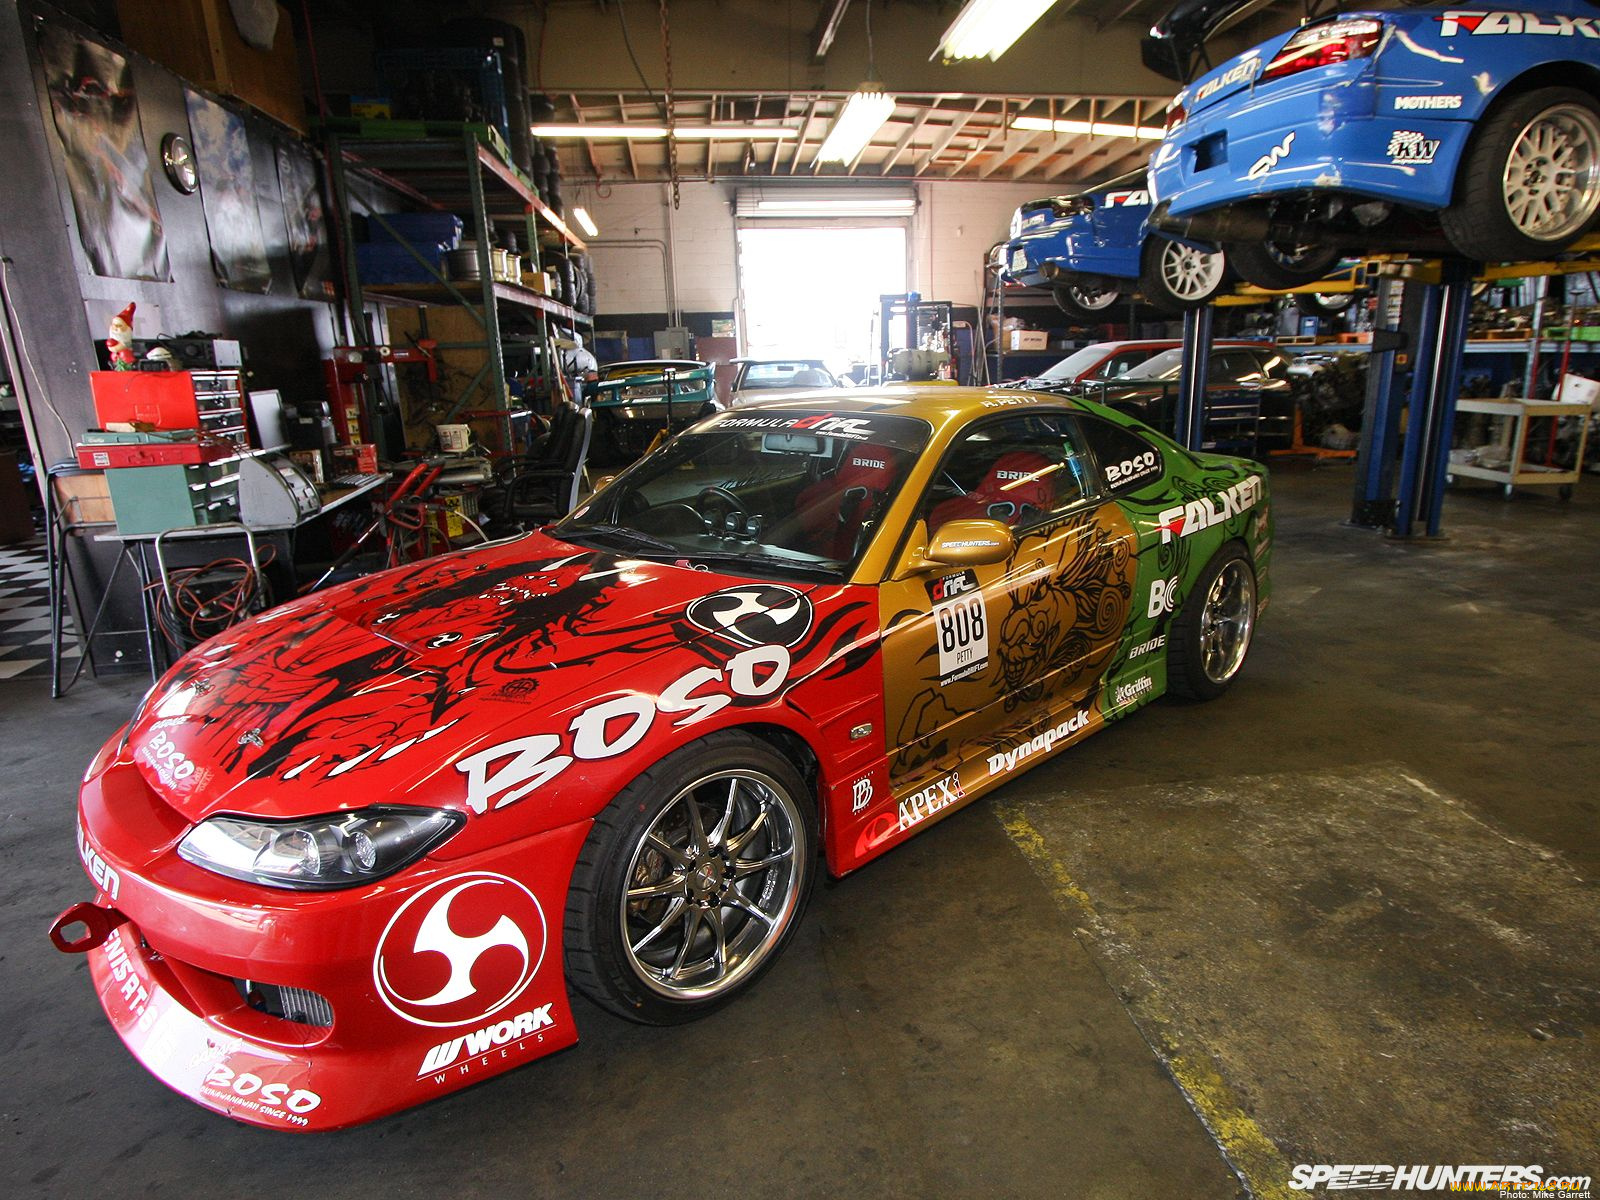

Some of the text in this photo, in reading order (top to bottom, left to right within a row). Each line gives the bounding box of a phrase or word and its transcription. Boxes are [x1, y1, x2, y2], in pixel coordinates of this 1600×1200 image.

[1439, 11, 1600, 38] FALK
[1394, 95, 1462, 110] MOTHERS
[1397, 139, 1441, 159] KW
[713, 418, 799, 429] FORMULA
[852, 457, 886, 470] BRIDE
[1104, 451, 1155, 482] BOSO
[1155, 474, 1262, 545] FALKEN
[942, 570, 966, 581] FORMULA
[938, 597, 985, 654] 808
[956, 646, 974, 665] PETTY
[1129, 633, 1167, 660] BRIDE
[1124, 676, 1153, 697] Griffin
[455, 645, 791, 816] BOSO
[986, 709, 1090, 776] Dynapack
[149, 731, 195, 779] BOSO
[466, 1002, 554, 1057] WORK
[434, 1033, 544, 1085] WHEELS
[204, 1062, 322, 1113] BOSO
[259, 1105, 287, 1119] SINCE
[286, 1113, 309, 1127] 1999
